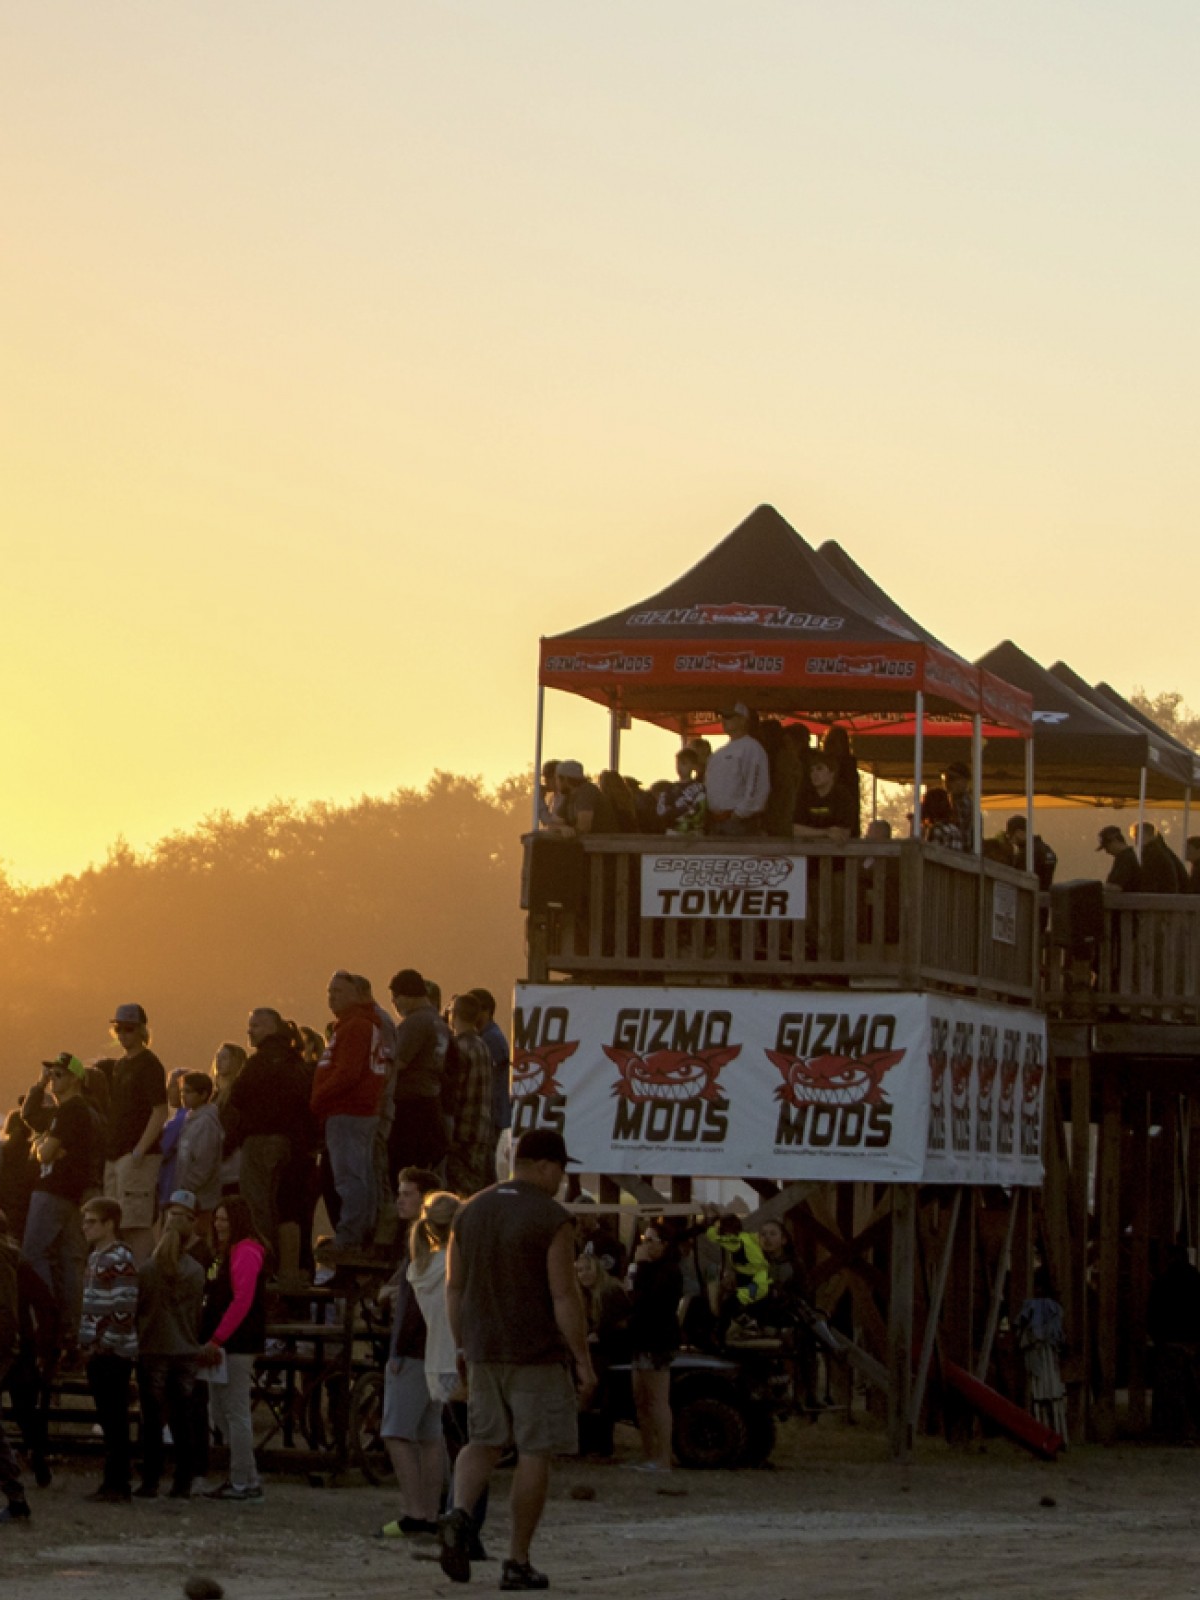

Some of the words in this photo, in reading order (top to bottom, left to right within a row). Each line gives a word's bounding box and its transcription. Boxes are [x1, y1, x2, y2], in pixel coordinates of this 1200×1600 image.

[613, 656, 653, 672] MODS
[744, 657, 784, 673] MODS
[875, 660, 916, 677] MODS
[679, 872, 764, 887] CYCLES
[657, 889, 790, 915] TOWER
[613, 1008, 734, 1053] GIZMO
[776, 1012, 897, 1057] GIZMO
[612, 1096, 730, 1143] MODS
[775, 1102, 894, 1148] MODS
